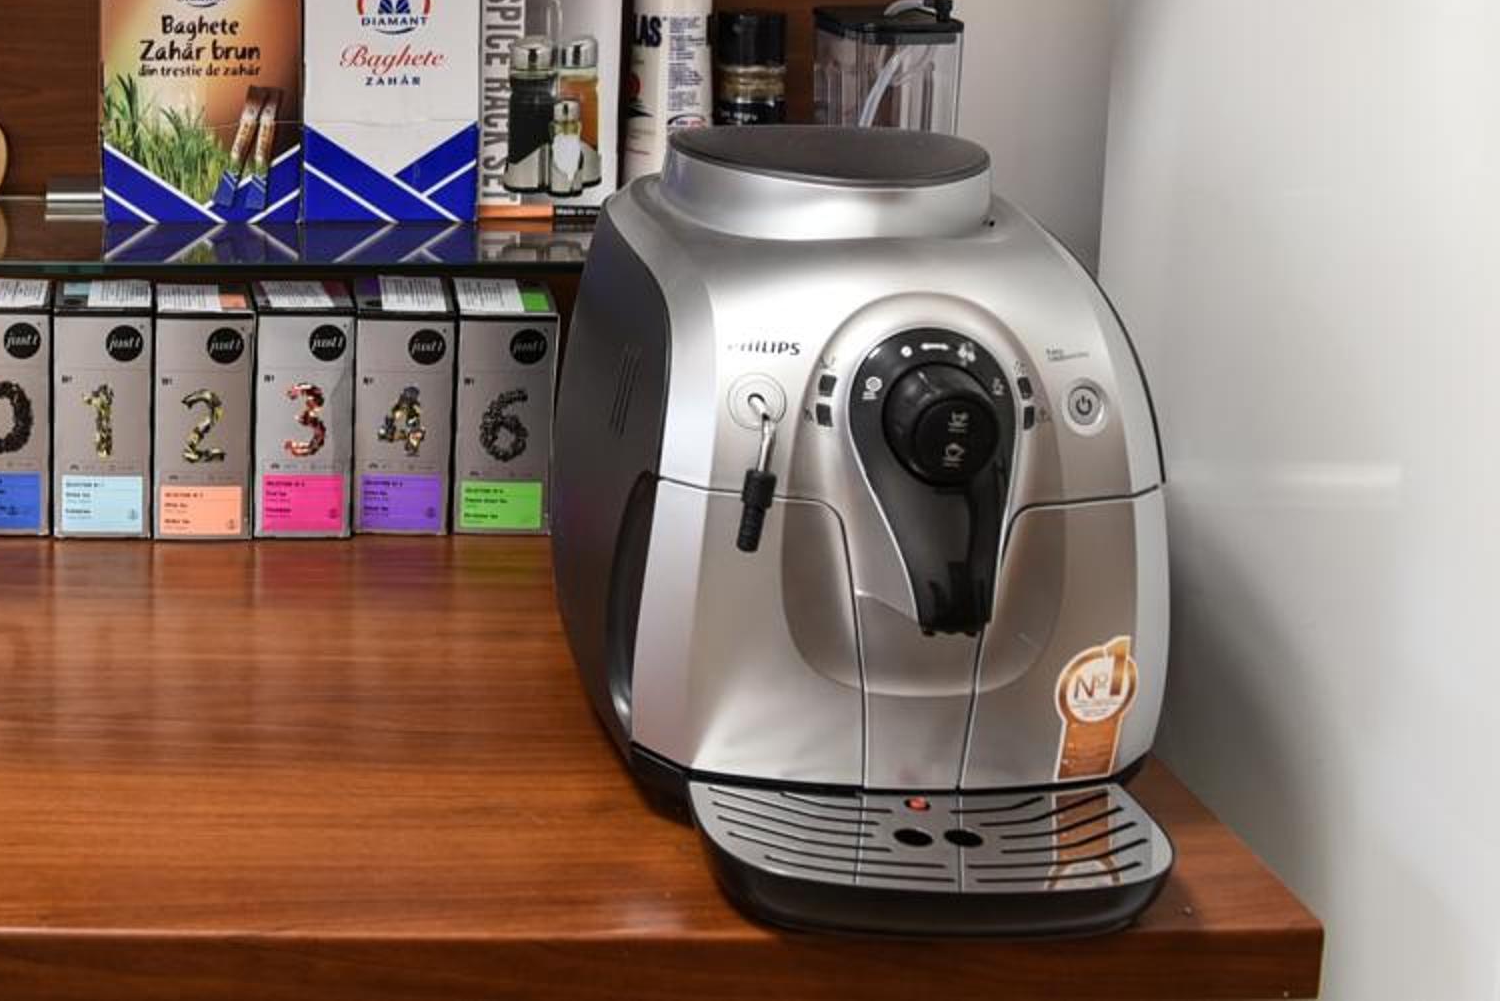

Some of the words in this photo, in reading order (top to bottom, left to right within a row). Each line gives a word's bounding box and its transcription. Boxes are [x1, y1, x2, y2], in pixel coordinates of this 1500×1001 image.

[161, 14, 239, 41] Baghete
[361, 16, 428, 26] DIAMANT
[160, 64, 202, 77] trestie
[205, 62, 220, 76] de
[211, 39, 260, 61] brun
[340, 42, 447, 76] Baghete
[83, 384, 114, 459] 1
[181, 388, 227, 463] 2
[284, 383, 327, 457] 3
[377, 386, 426, 456] 4
[480, 388, 529, 462] 6
